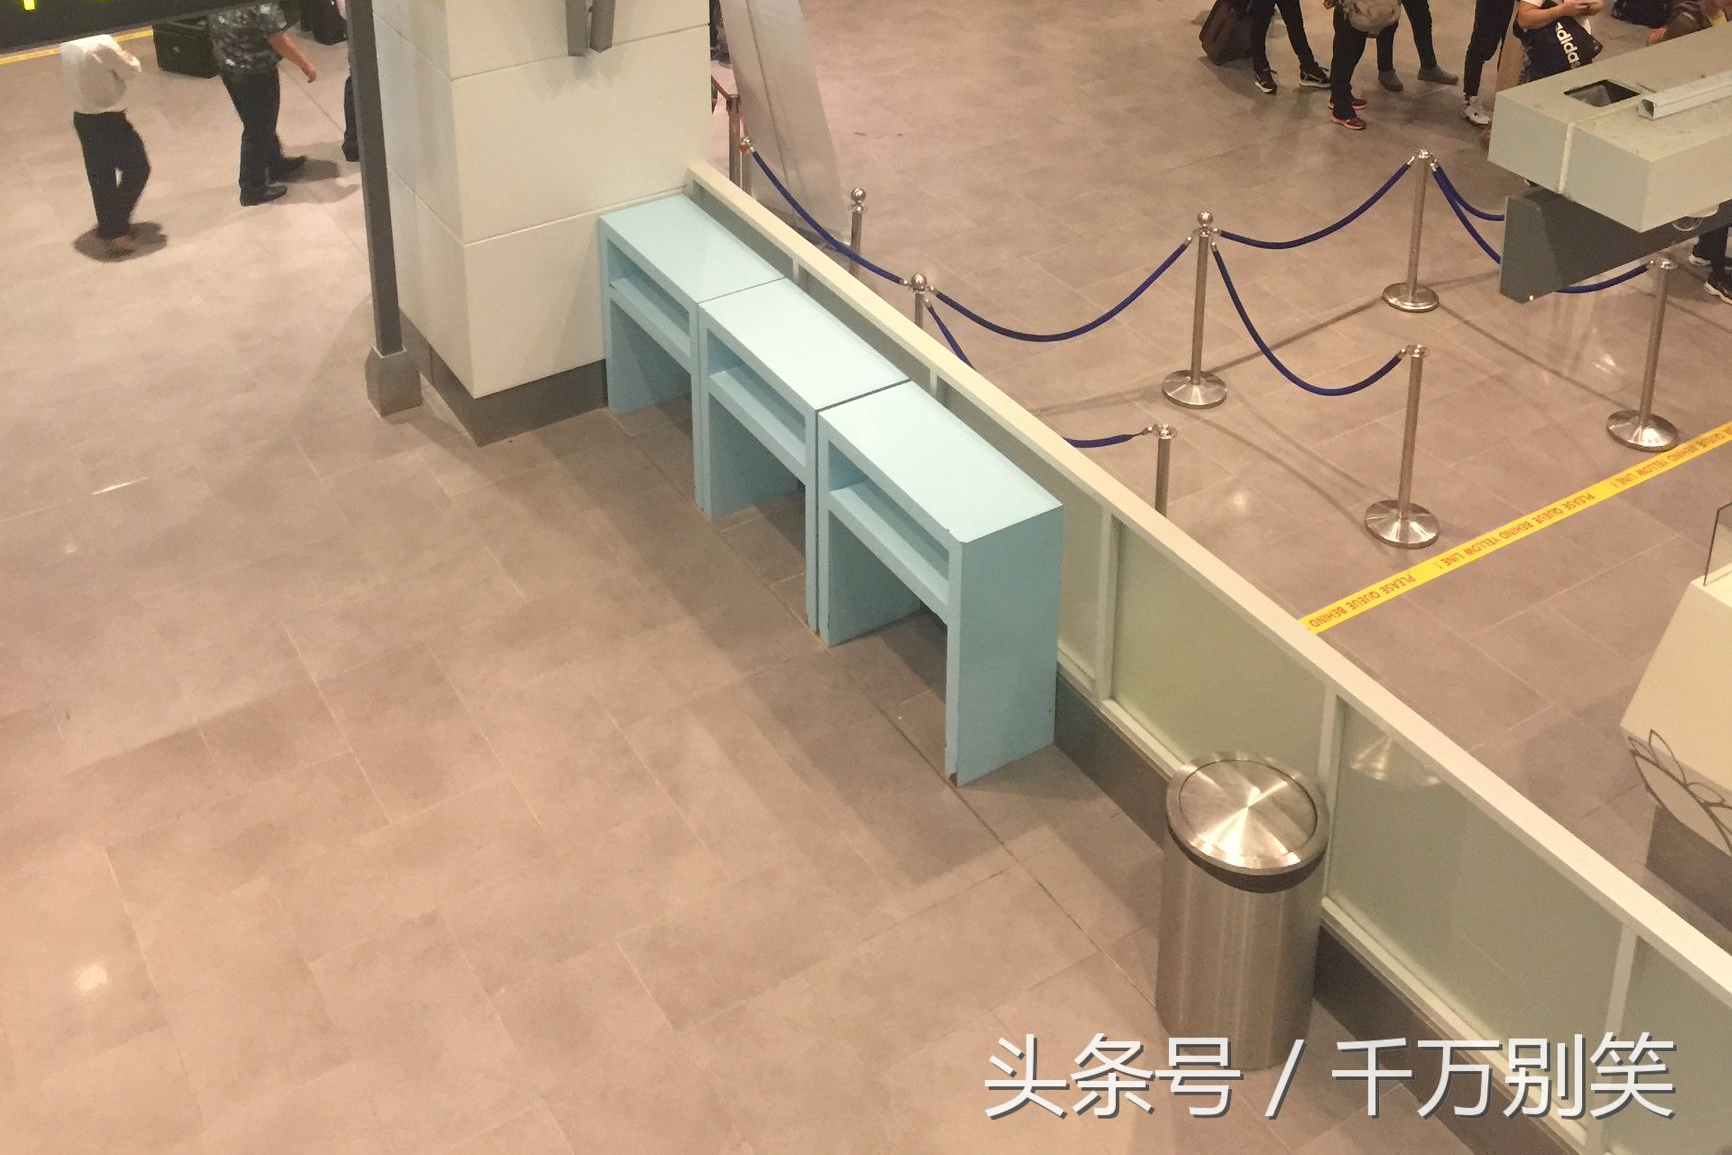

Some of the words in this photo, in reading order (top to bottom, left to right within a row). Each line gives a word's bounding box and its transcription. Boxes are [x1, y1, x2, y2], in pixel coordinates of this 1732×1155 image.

[1636, 458, 1669, 476] YELLOW
[1614, 472, 1637, 486] LINE
[1562, 492, 1596, 512] PLEASE
[1532, 507, 1564, 525] QUEUE
[1498, 520, 1535, 540] BEHIND
[1463, 536, 1500, 556] YELLOW
[1440, 551, 1466, 567] LINE
[1378, 574, 1417, 595] PLEASE
[1345, 590, 1381, 611] QUEUE
[1308, 606, 1348, 628] BEHIND
